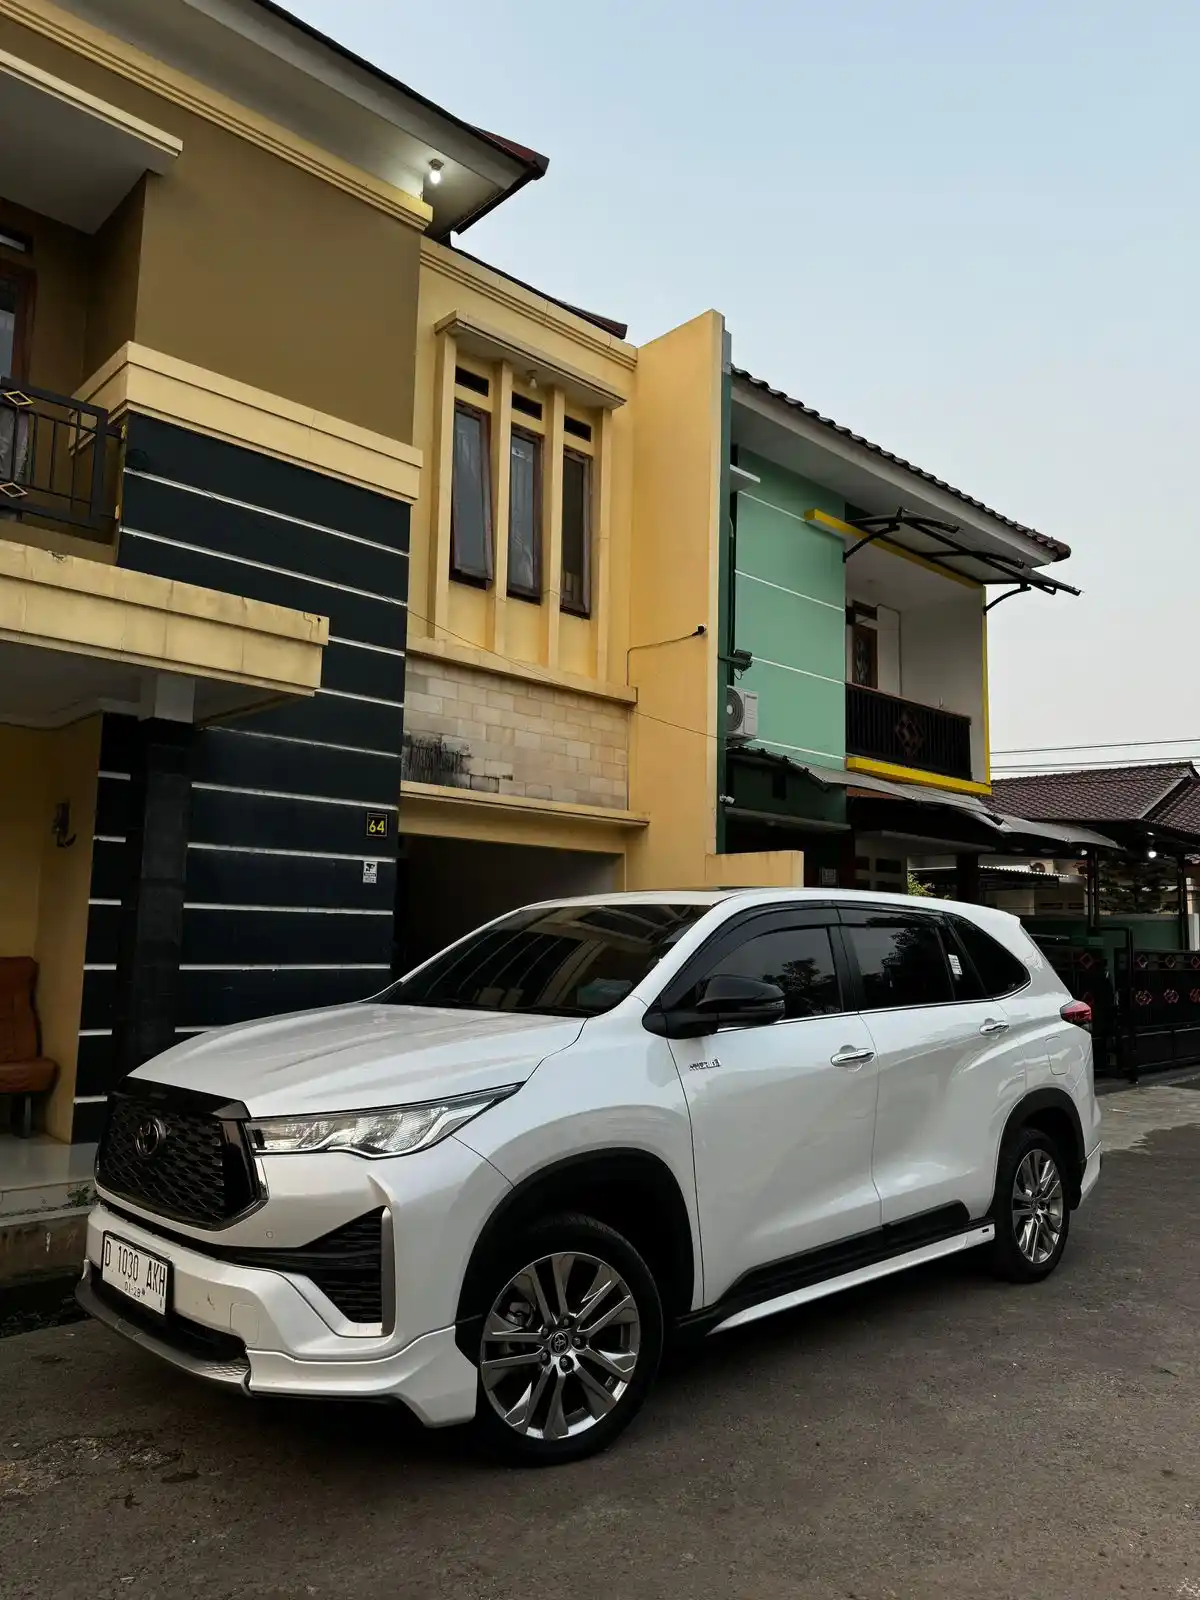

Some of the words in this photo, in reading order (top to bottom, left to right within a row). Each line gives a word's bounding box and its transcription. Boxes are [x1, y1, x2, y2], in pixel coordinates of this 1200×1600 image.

[369, 820, 385, 833] 64
[105, 1240, 111, 1267] D
[118, 1246, 139, 1281] 1030
[146, 1260, 166, 1297] AKH
